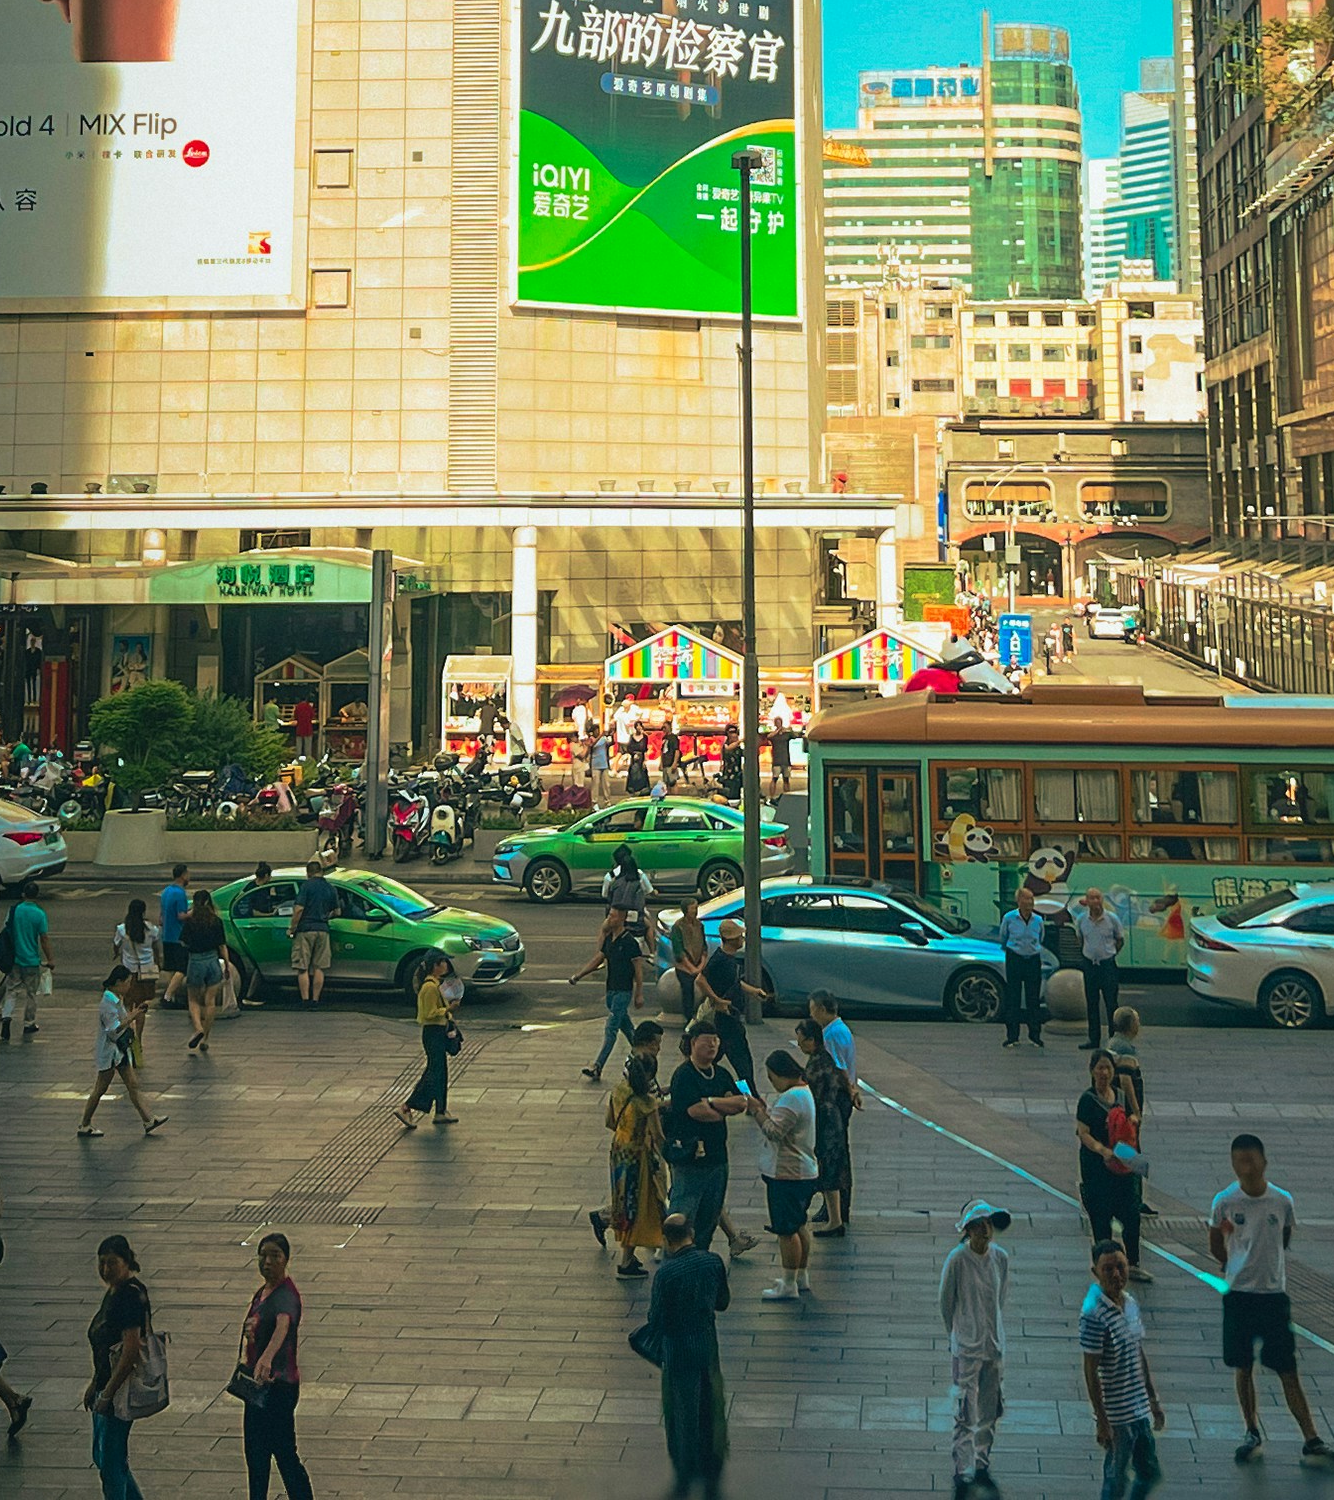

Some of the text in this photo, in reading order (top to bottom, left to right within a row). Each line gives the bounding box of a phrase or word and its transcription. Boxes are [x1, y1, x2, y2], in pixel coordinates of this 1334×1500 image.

[530, 0, 785, 83] 九部的检察官
[613, 76, 708, 102] 爱奇艺原创剧集
[39, 115, 55, 136] 4
[79, 114, 126, 136] MIX
[134, 112, 178, 140] Flip
[533, 163, 591, 190] iQIYI
[533, 190, 590, 221] 爱奇艺
[696, 206, 785, 235] 一起守护
